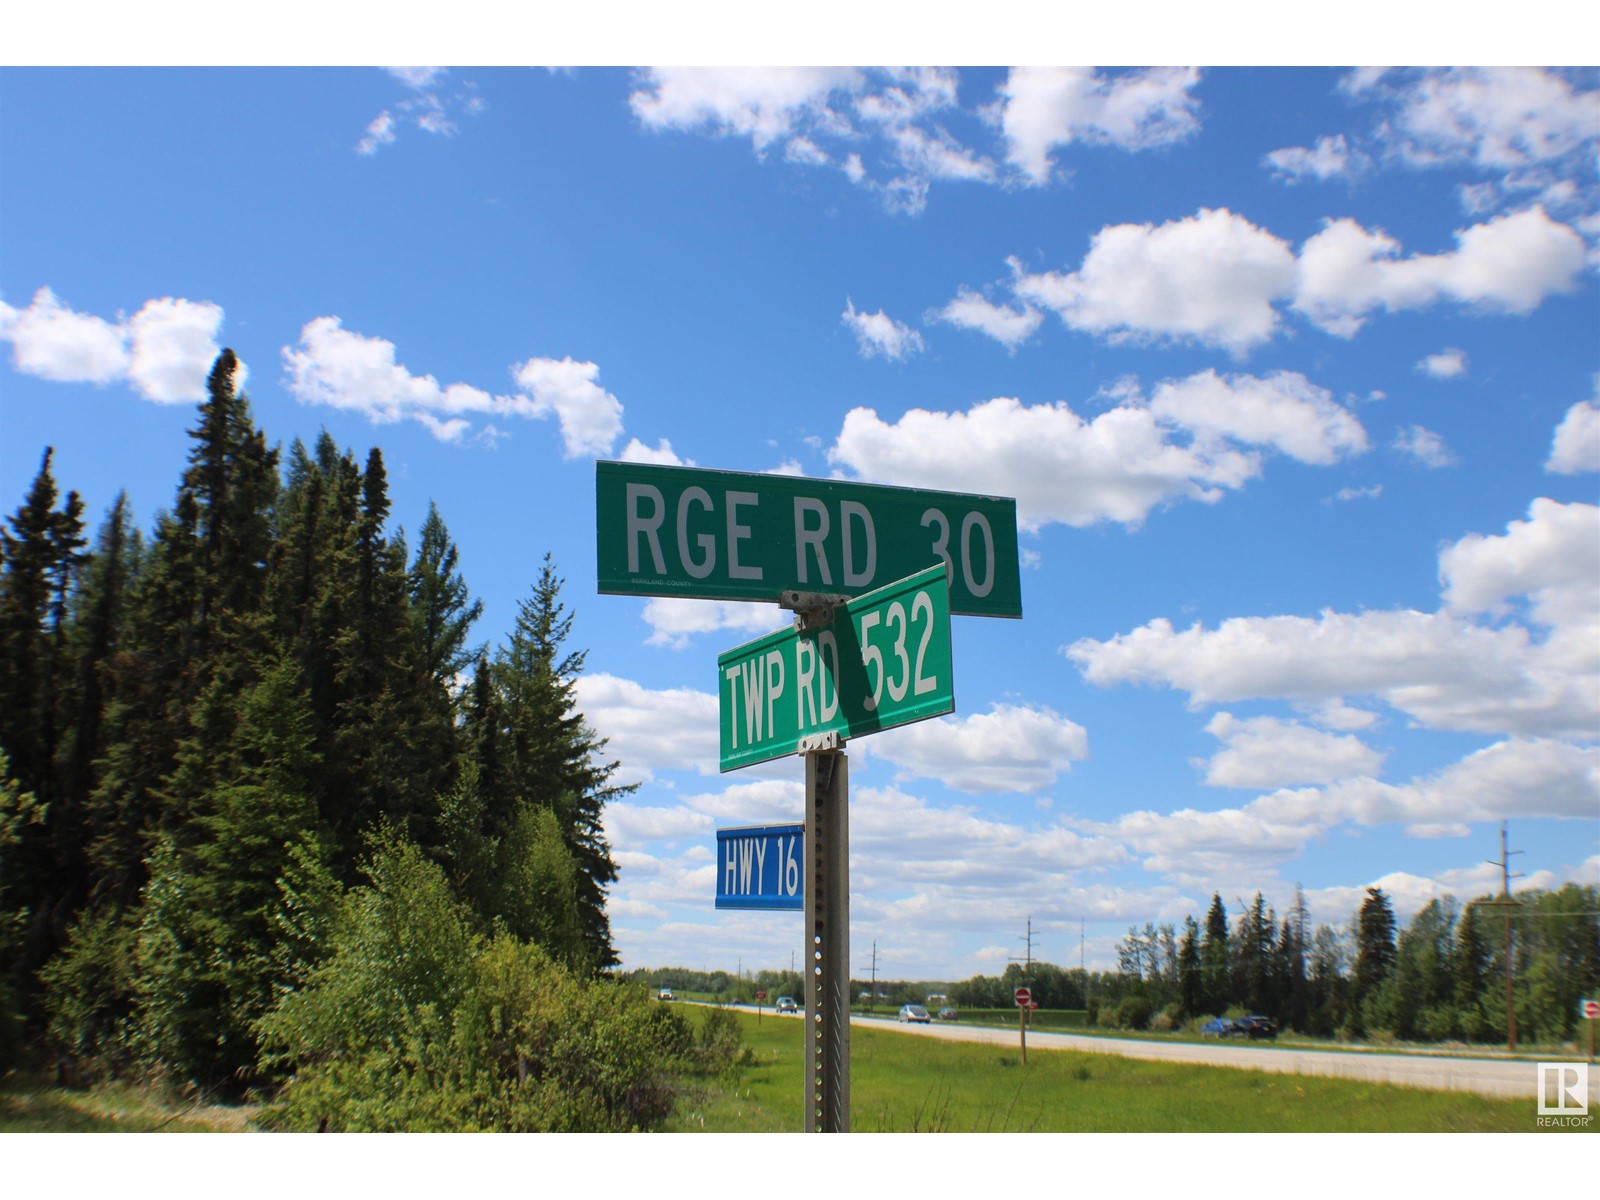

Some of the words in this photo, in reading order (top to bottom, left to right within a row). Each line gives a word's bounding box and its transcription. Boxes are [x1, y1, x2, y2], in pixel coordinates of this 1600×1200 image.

[625, 482, 763, 580] RGE
[793, 496, 877, 588] RD
[920, 508, 995, 598] 30
[631, 578, 664, 586] PARKLAND
[726, 649, 785, 750] TWP
[796, 630, 840, 730] RD
[861, 590, 937, 712] 532
[725, 837, 767, 896] HWY
[777, 835, 798, 897] 16
